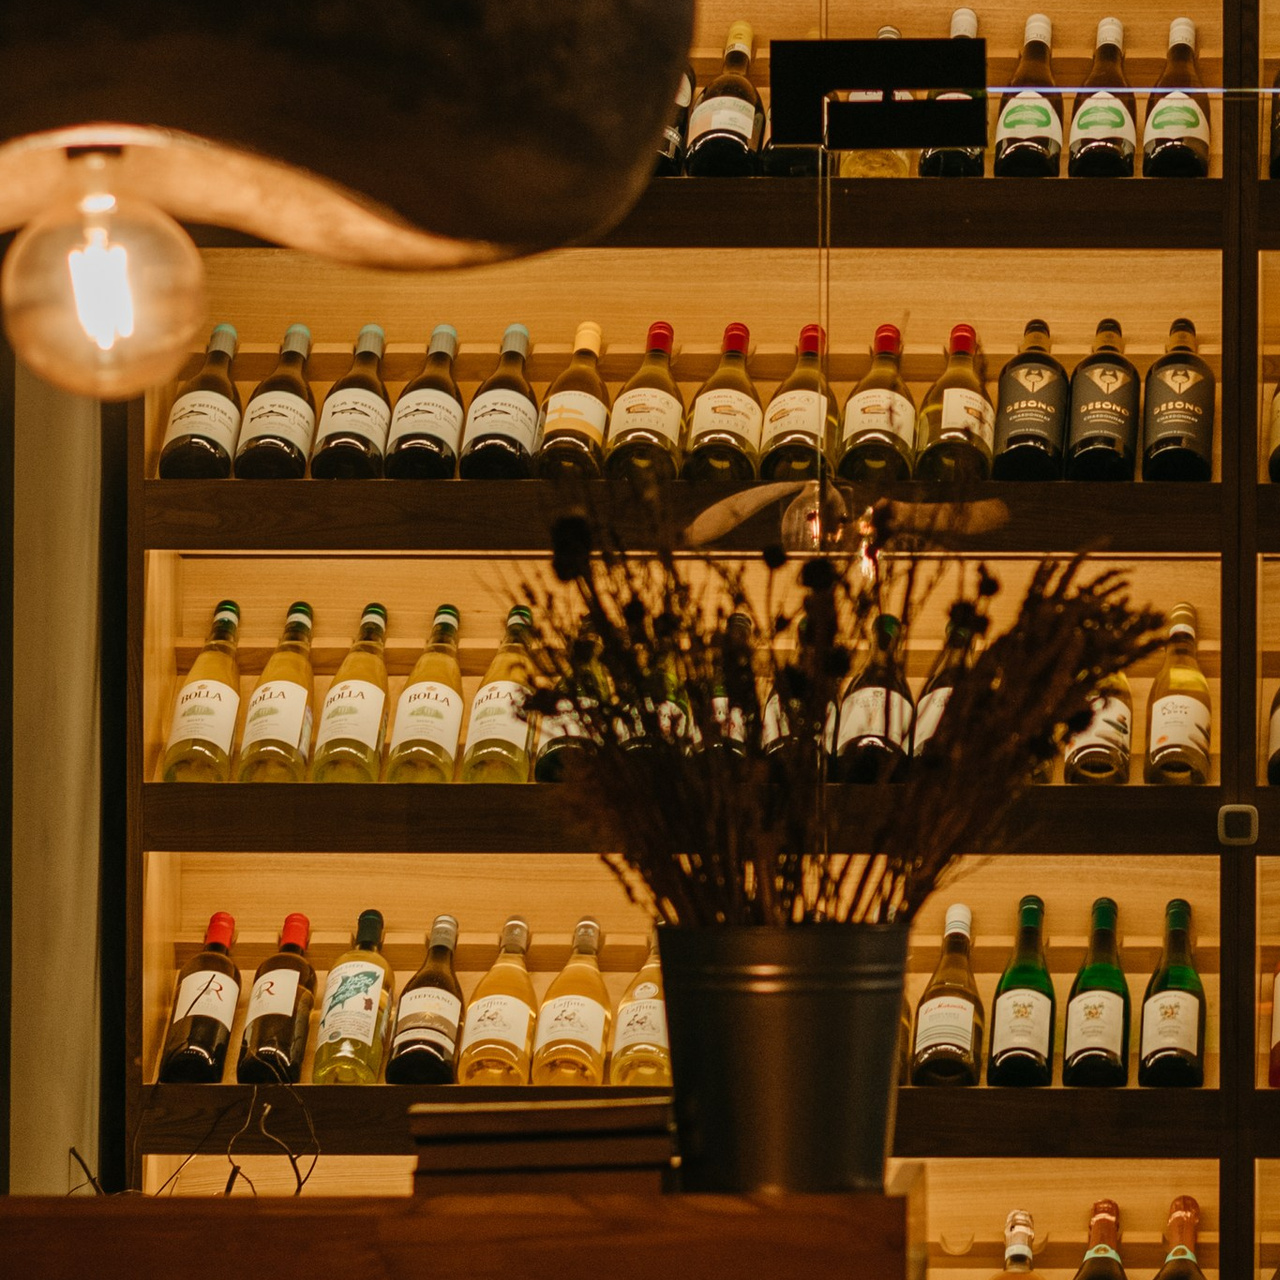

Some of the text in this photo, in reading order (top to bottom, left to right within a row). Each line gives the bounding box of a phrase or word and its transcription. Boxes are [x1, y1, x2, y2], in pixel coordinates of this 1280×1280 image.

[1007, 400, 1055, 414] DESONO
[1080, 401, 1130, 416] DESONO
[1153, 401, 1203, 415] DESONO
[1009, 413, 1050, 421] CHARDONNAY
[1083, 415, 1125, 424] CHARDONNAY
[1156, 415, 1198, 423] CHARDONNAY
[180, 690, 222, 705] BOLLA
[251, 691, 287, 707] BOLLA
[325, 690, 365, 708] BOLLA
[408, 691, 451, 707] BOLLA
[474, 691, 513, 709] BOLLA
[477, 1000, 508, 1010] Laffitte
[553, 999, 586, 1009] Laffitte
[626, 1005, 657, 1015] Laffitte
